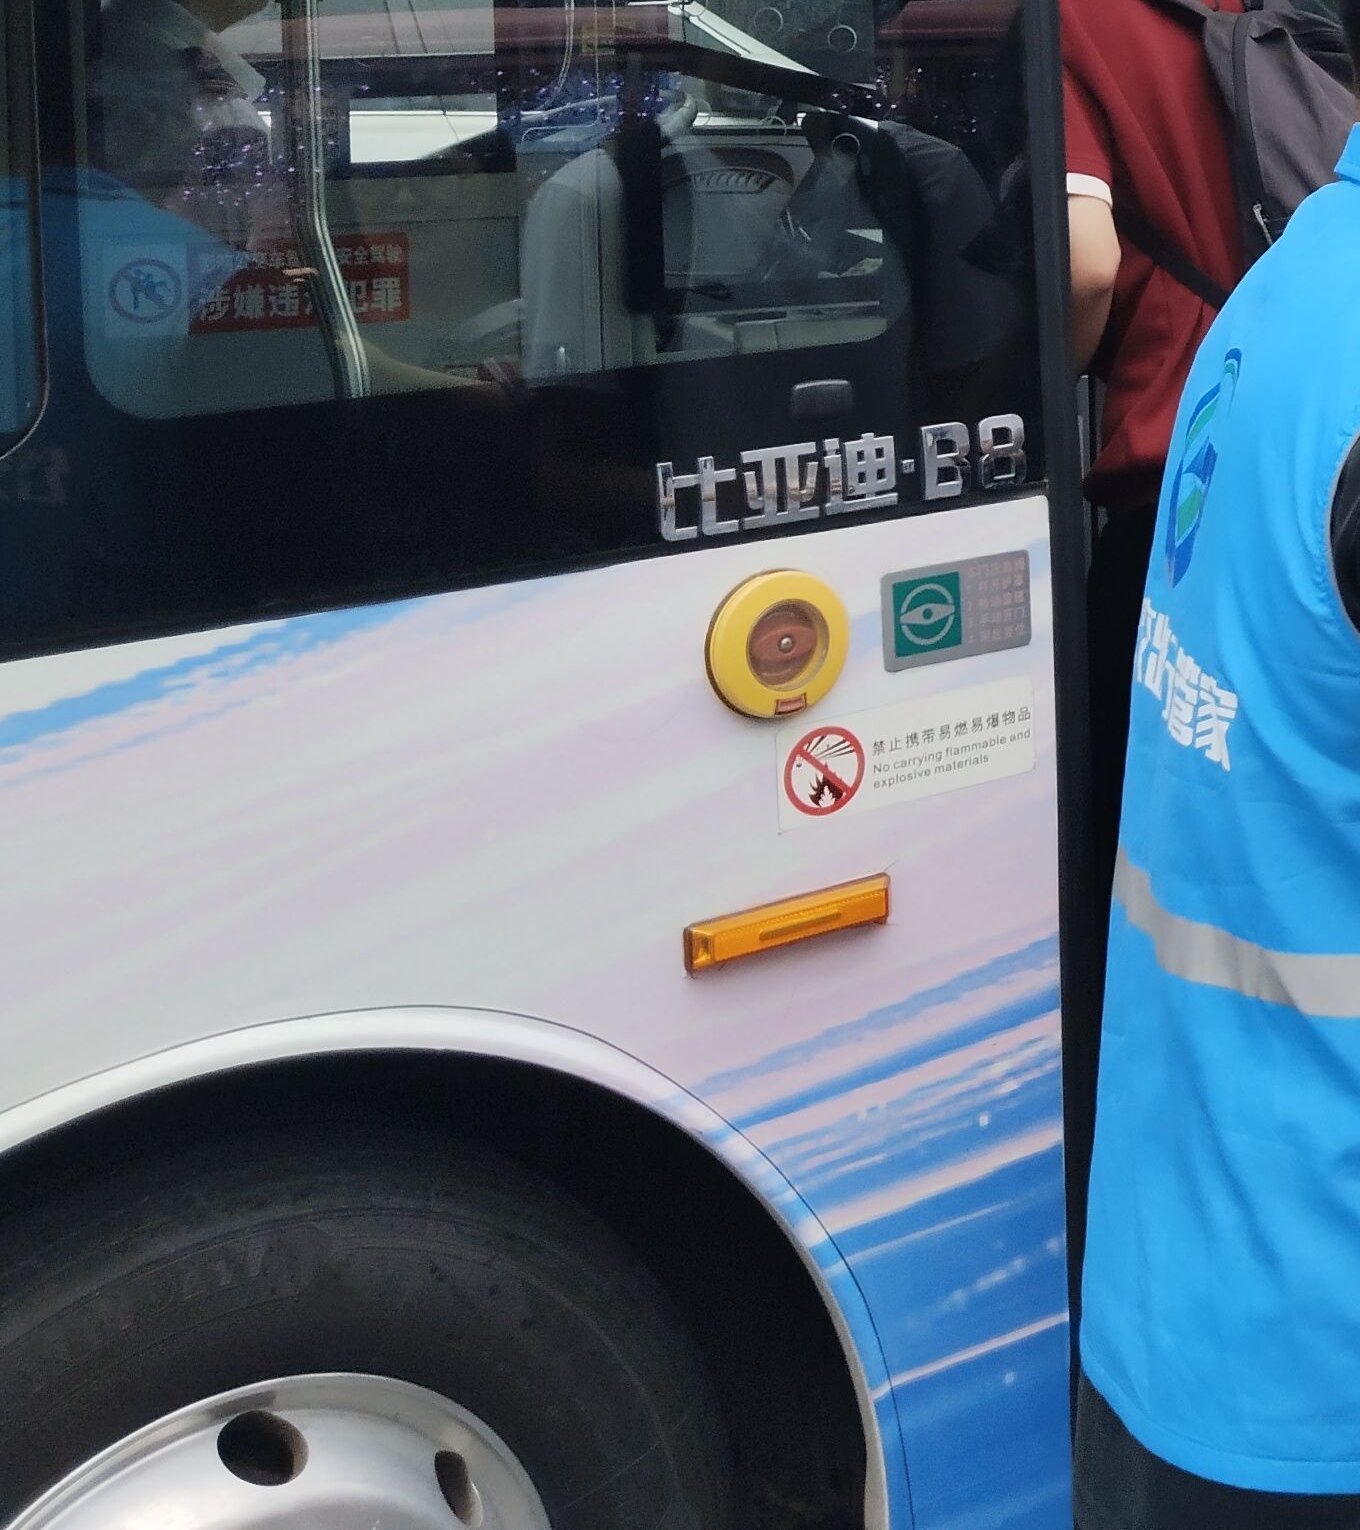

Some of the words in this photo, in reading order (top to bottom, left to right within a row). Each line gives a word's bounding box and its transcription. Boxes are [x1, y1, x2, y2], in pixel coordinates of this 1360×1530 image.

[872, 706, 1032, 757] 禁止携带易燃易爆物品
[873, 763, 890, 774] No
[893, 751, 942, 770] carrying
[945, 732, 1007, 758] flammable
[1009, 728, 1031, 743] and
[873, 769, 931, 789] explosive
[934, 753, 989, 773] materials
